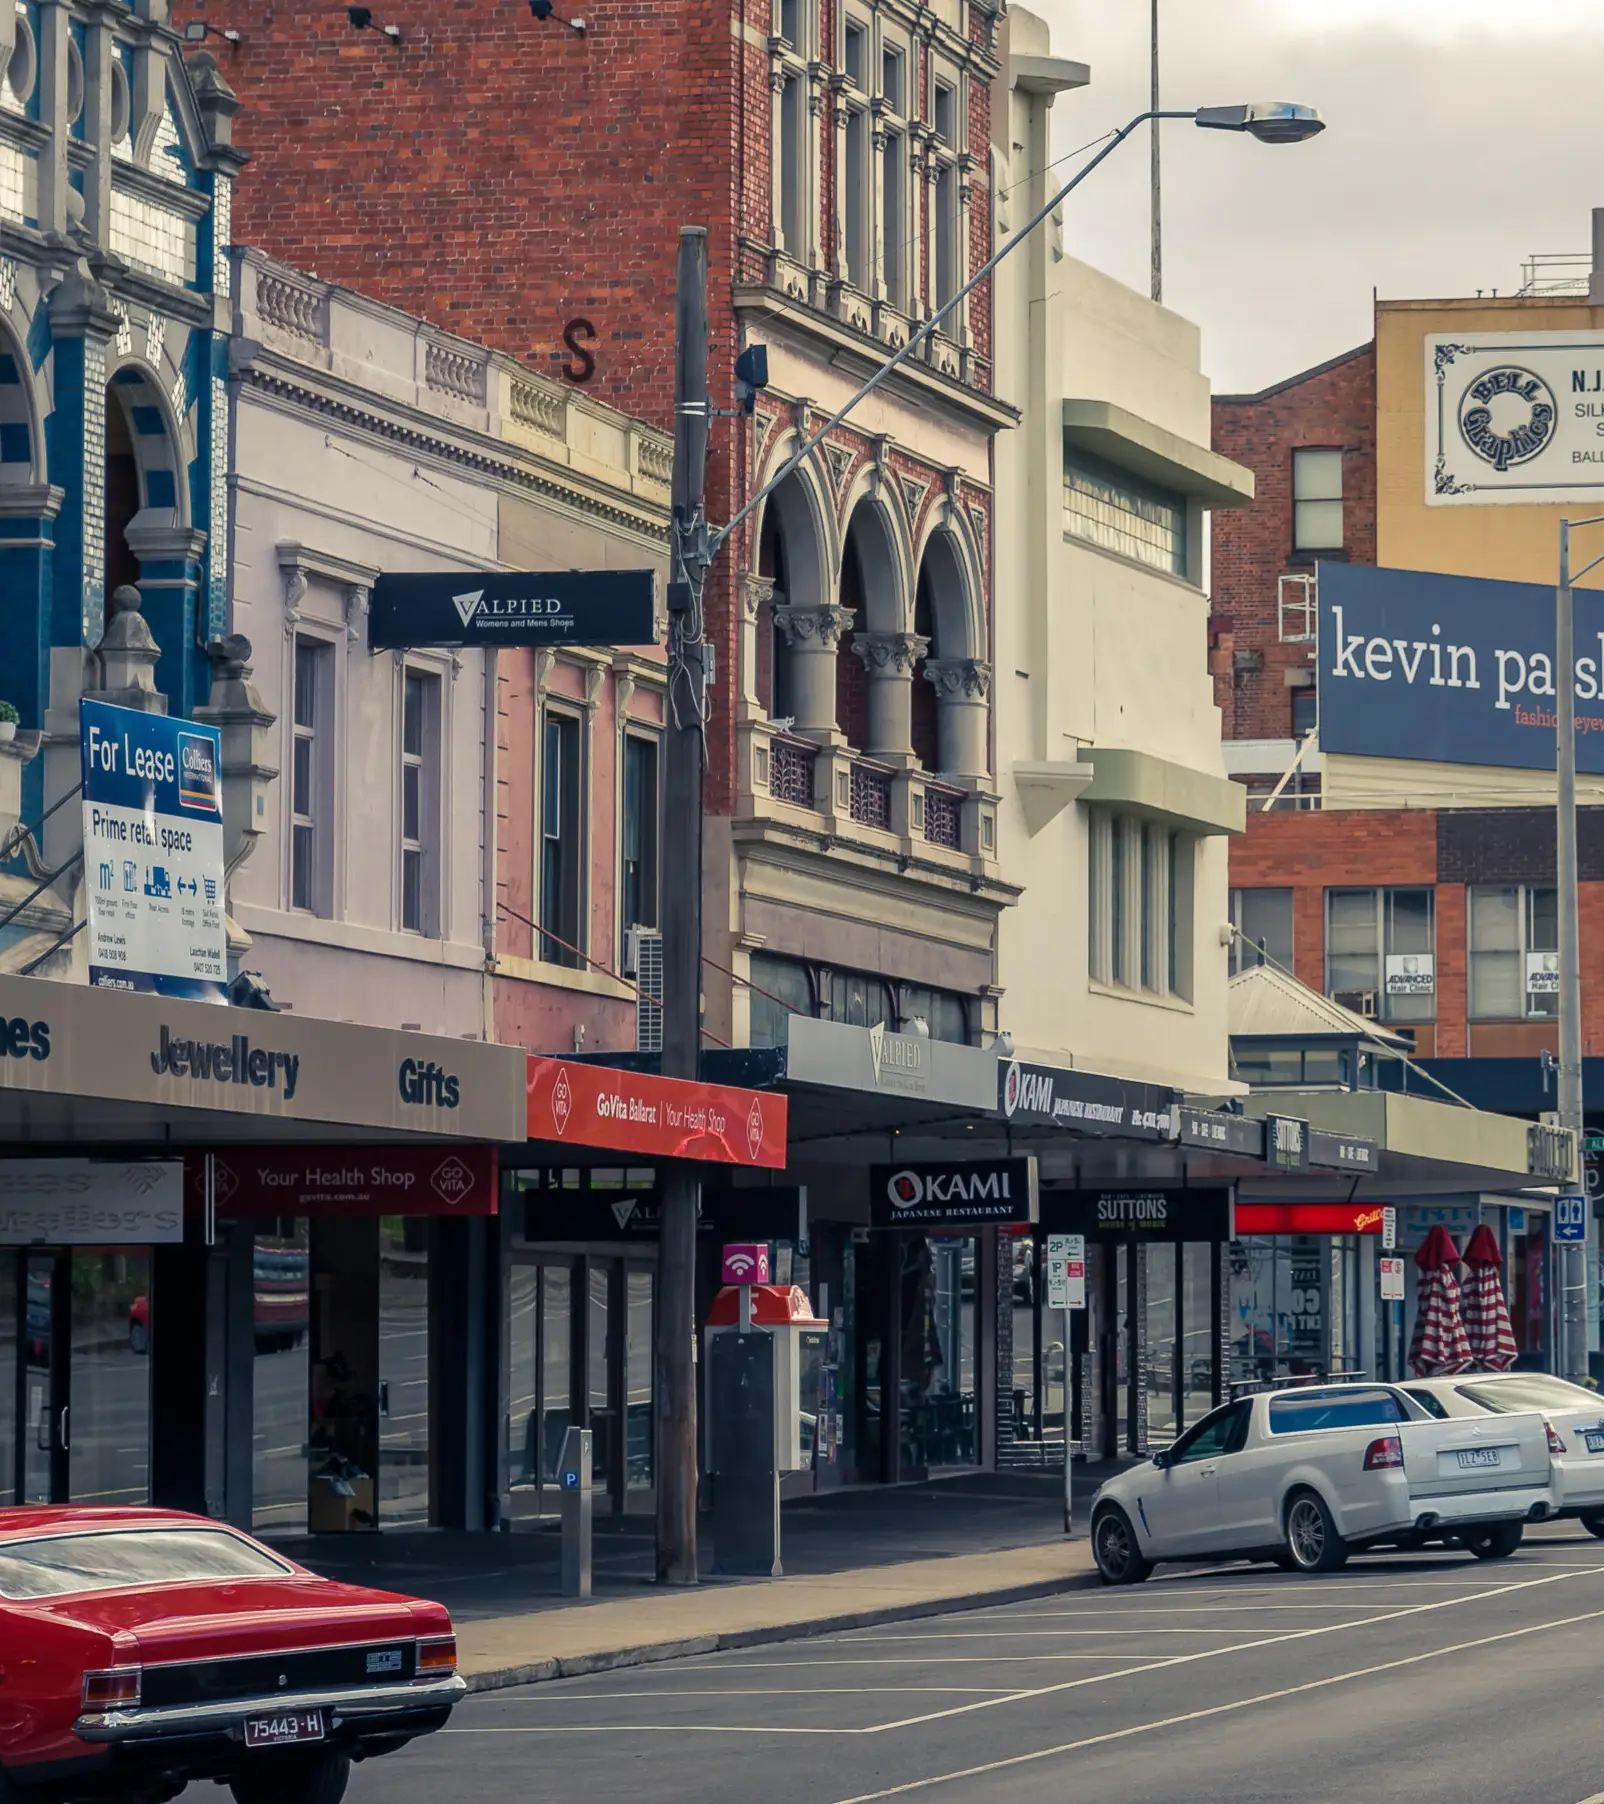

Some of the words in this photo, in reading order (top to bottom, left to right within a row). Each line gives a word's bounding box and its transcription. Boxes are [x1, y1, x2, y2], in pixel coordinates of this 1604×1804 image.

[562, 317, 596, 384] S
[1470, 370, 1543, 405] BELL
[1463, 403, 1554, 473] Graphics
[457, 599, 561, 616] VALPIED
[475, 619, 508, 628] Womens
[510, 619, 526, 628] and
[527, 618, 548, 628] Mens
[550, 618, 575, 628] Shoes
[1331, 605, 1481, 689] kevin
[1514, 704, 1562, 729] fashio
[89, 725, 119, 772] For
[124, 732, 174, 783] Lease
[182, 746, 212, 773] Colliers
[92, 808, 127, 842] Prime
[161, 827, 192, 857] space
[98, 974, 135, 991] colliers.com.au
[1387, 974, 1433, 985] ADVANCED
[1390, 984, 1407, 993] Hair
[1409, 984, 1432, 993] Clinic
[1531, 981, 1548, 990] Hair
[150, 1025, 300, 1100] Jewellery
[872, 1035, 921, 1069] VALPIED
[399, 1056, 461, 1110] Gifts
[556, 1082, 568, 1099] GO
[1004, 1061, 1054, 1118] OKAMI
[555, 1101, 567, 1117] VITA
[628, 1096, 656, 1124] Ballarat
[665, 1102, 683, 1126] Your
[684, 1105, 706, 1131] Health
[707, 1108, 726, 1134] Shop
[750, 1111, 760, 1127] GO
[749, 1125, 760, 1142] VITA
[256, 1168, 299, 1186] Your
[305, 1168, 364, 1186] Health
[370, 1166, 416, 1190] Shop
[441, 1167, 464, 1179] GO
[439, 1180, 465, 1191] VITA
[887, 1170, 1011, 1209] OKAMI
[890, 1207, 943, 1221] JAPANESE
[946, 1205, 1015, 1217] RESTAURANT
[1097, 1198, 1168, 1220] SUTTONS
[1049, 1241, 1063, 1253] 2P
[273, 1734, 298, 1742] VICTORIA
